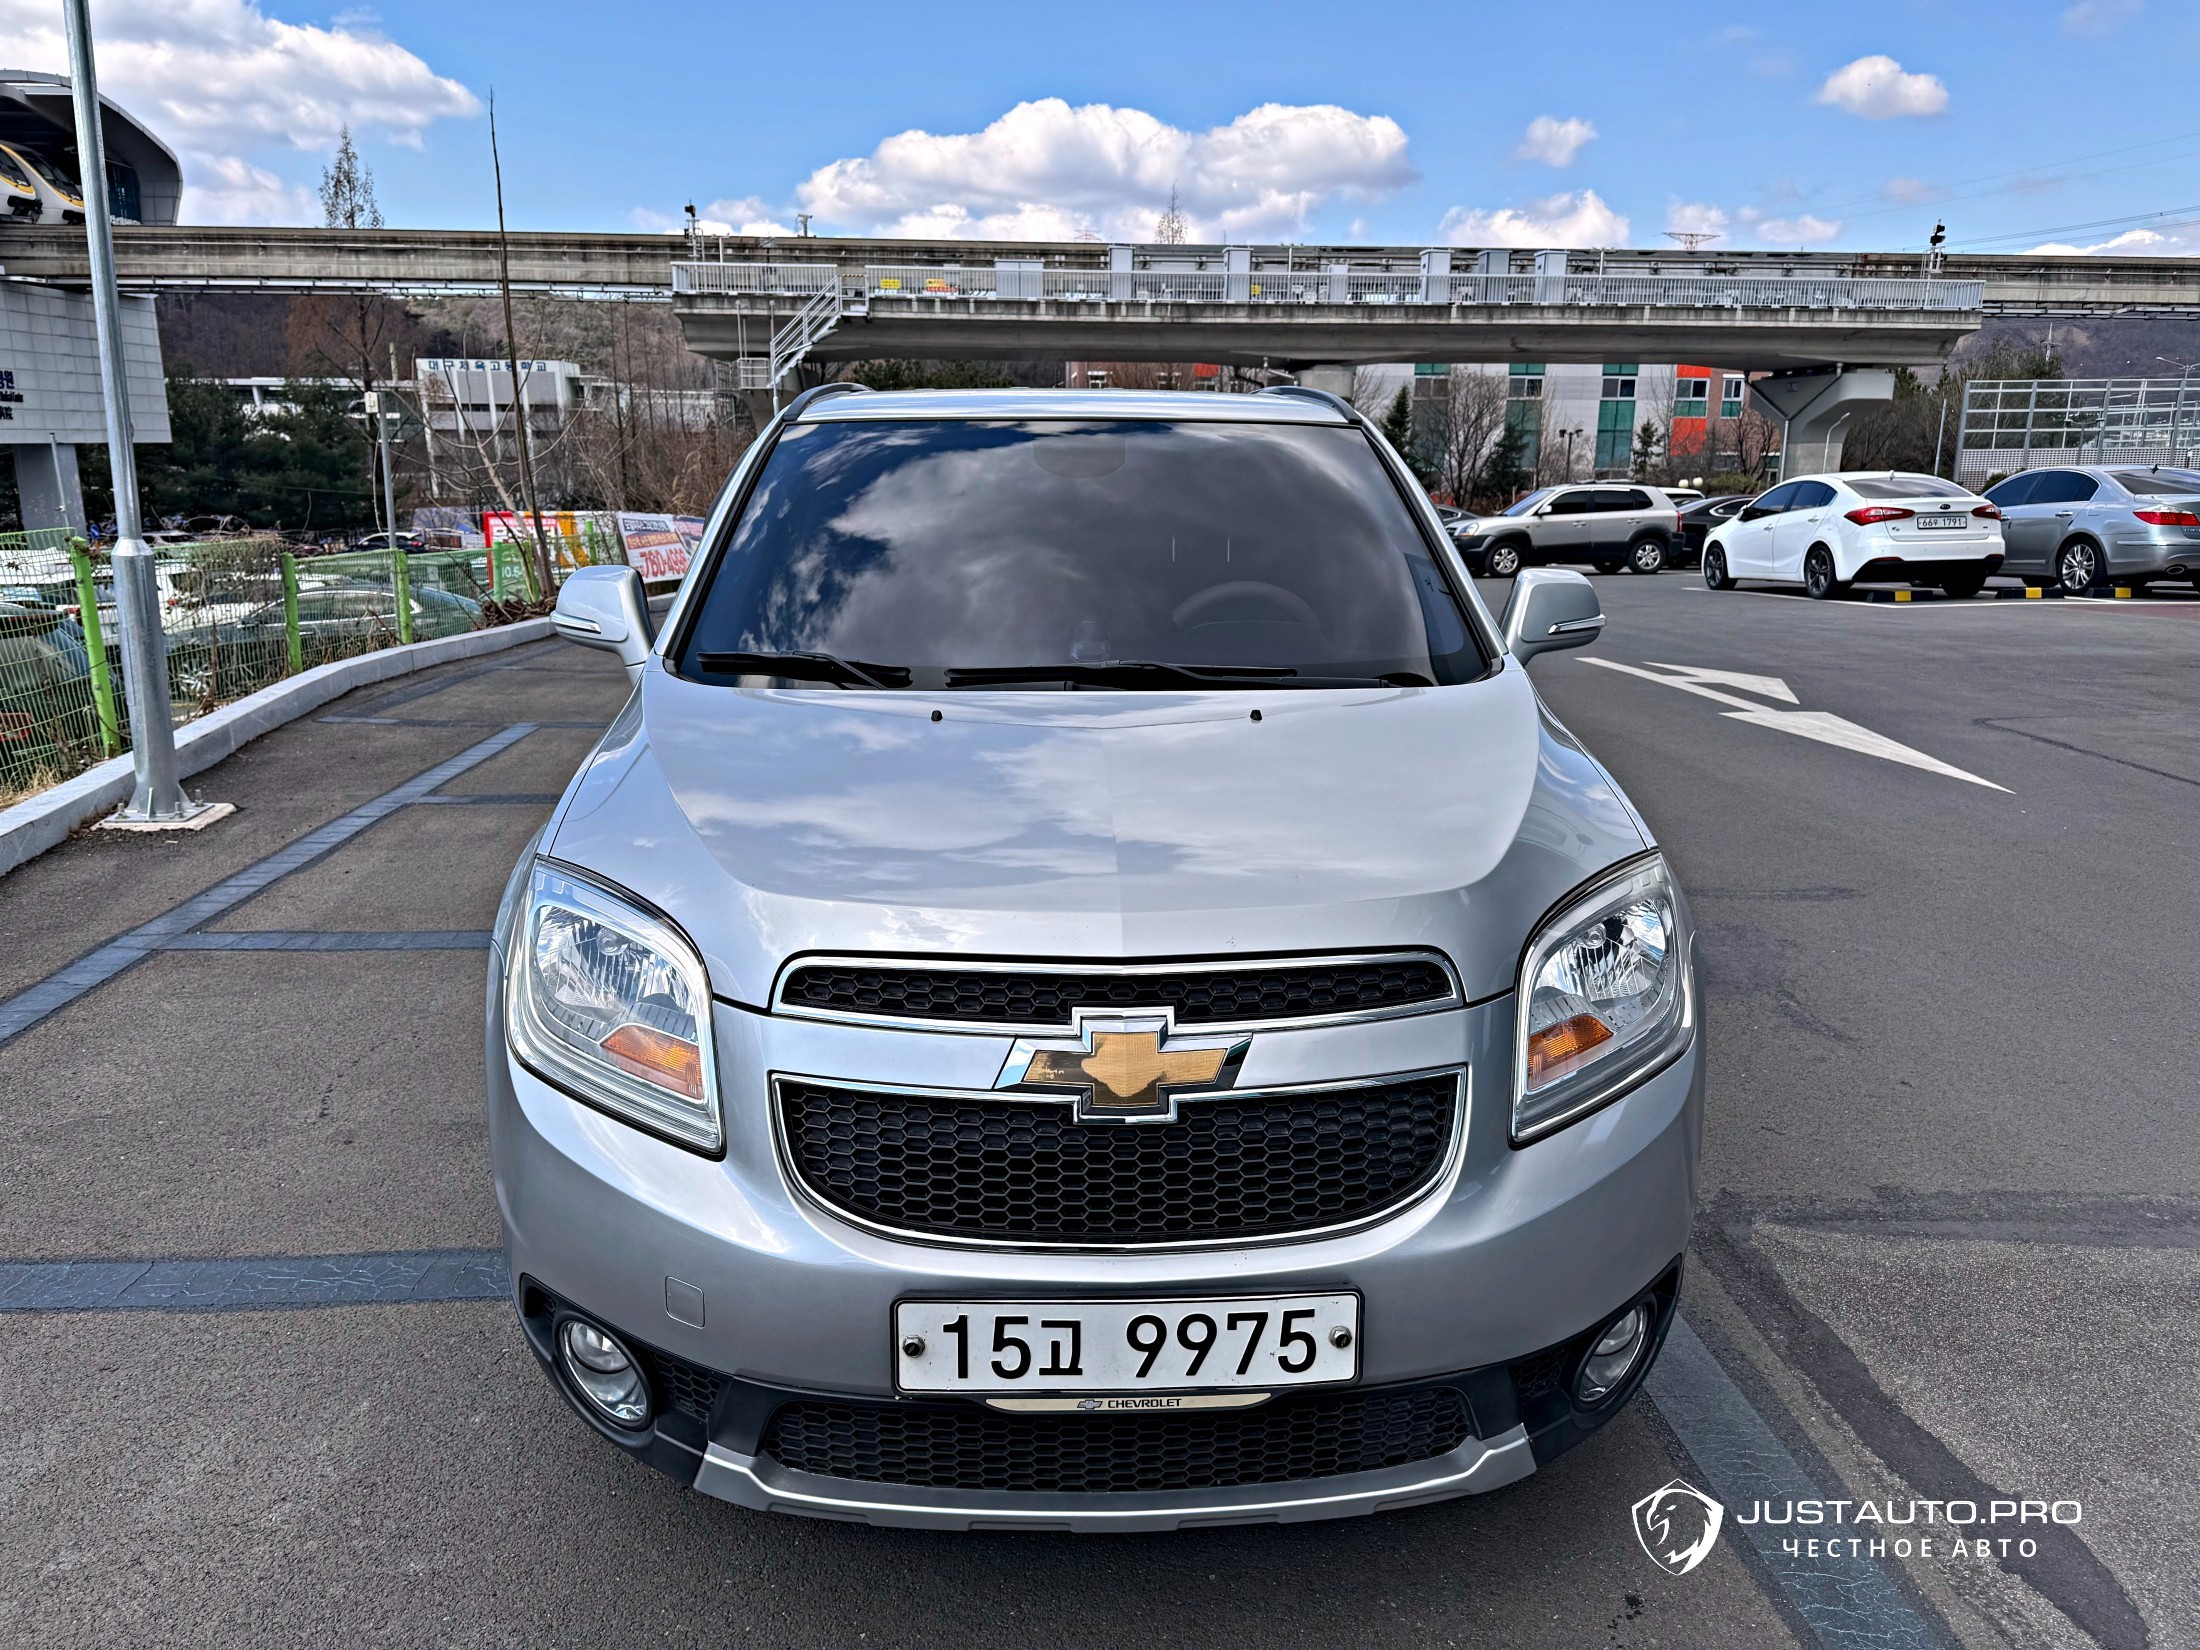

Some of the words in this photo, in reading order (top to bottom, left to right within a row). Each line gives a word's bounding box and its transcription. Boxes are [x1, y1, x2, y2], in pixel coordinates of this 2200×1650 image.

[1942, 518, 1961, 526] 1791
[943, 1314, 1083, 1380] 15고
[1126, 1308, 1317, 1378] 9975
[1107, 1398, 1182, 1409] CHEVROLET
